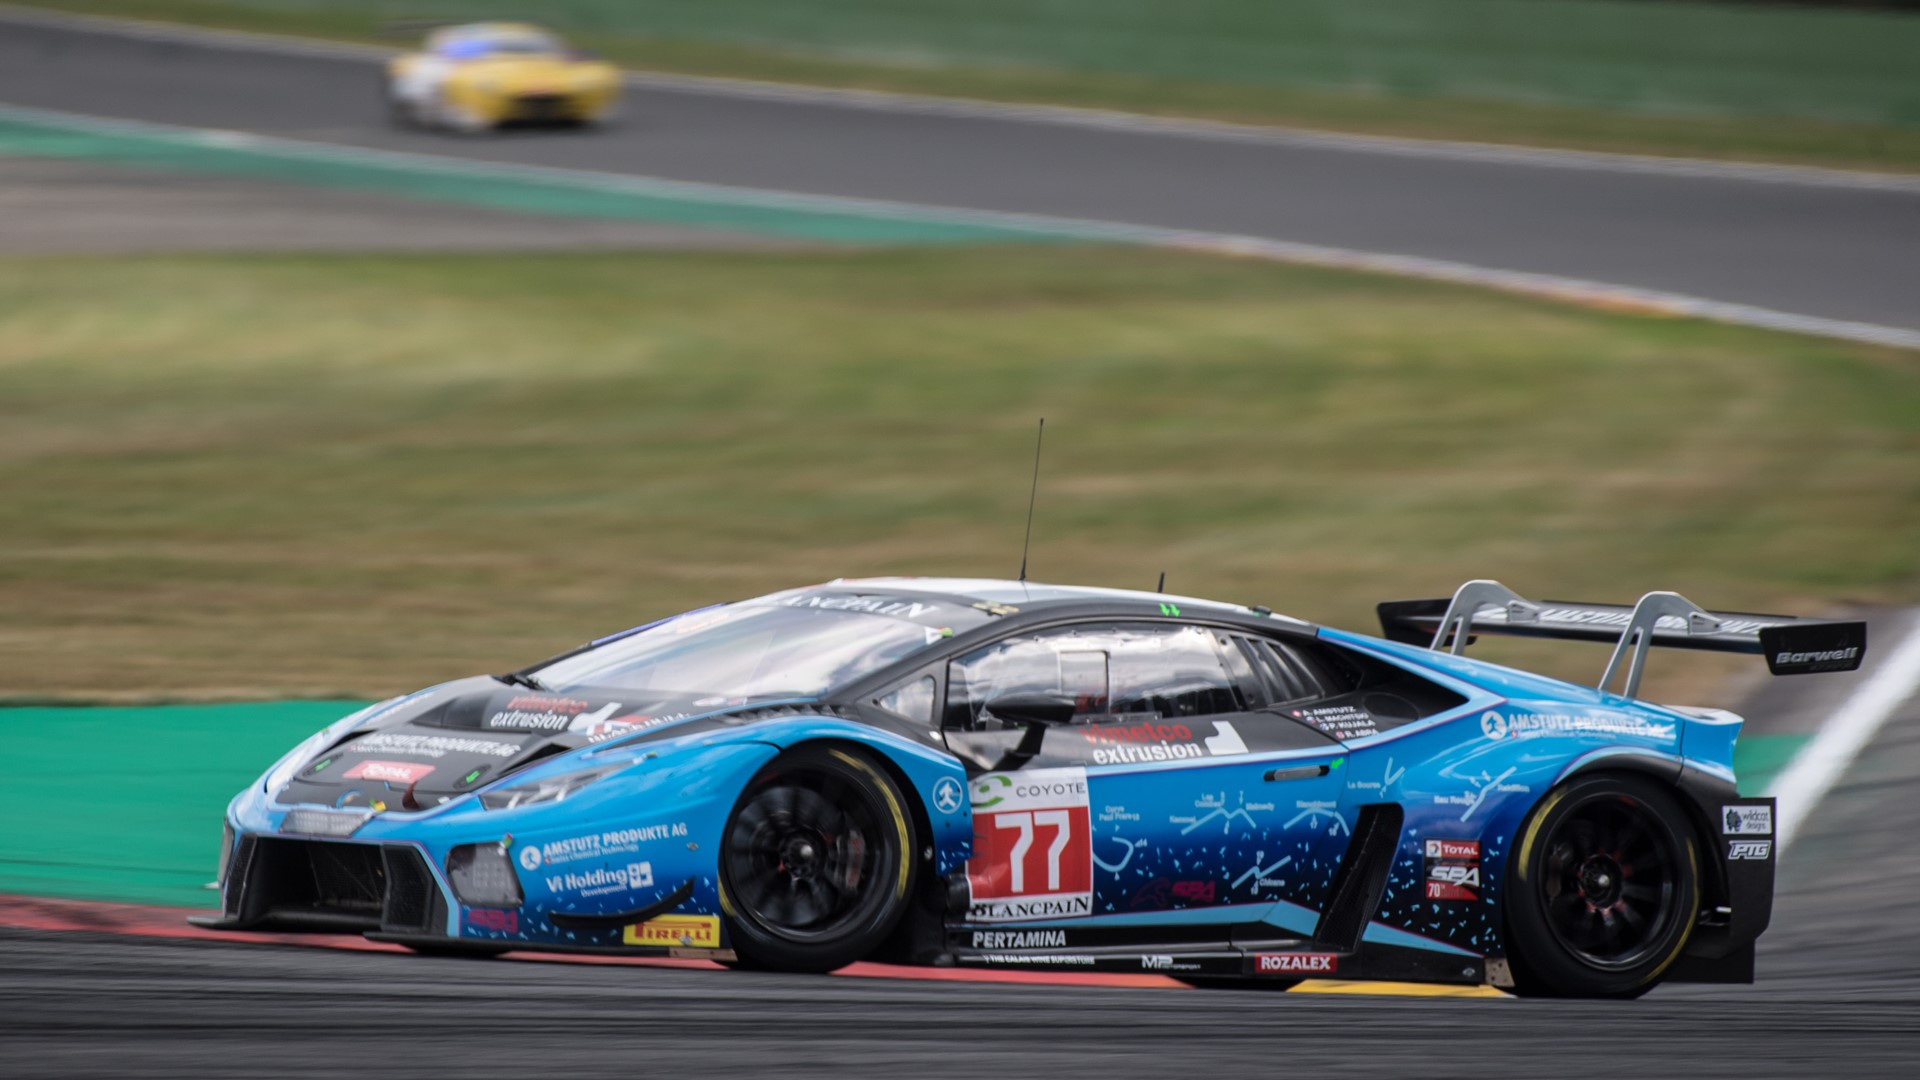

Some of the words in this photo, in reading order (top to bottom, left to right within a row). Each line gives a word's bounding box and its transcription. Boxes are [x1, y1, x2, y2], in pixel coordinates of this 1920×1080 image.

[1776, 647, 1859, 664] Barwell
[490, 710, 568, 731] extrusion
[1508, 713, 1570, 730] AMSTUTZ
[1079, 722, 1192, 744] vimetco
[1093, 740, 1203, 765] extrusion
[1016, 782, 1086, 798] COYOTE
[543, 834, 601, 858] AMSTUTZ
[602, 823, 670, 847] PRODUKTE
[671, 822, 688, 837] AG
[1443, 844, 1478, 855] TOTAL
[994, 810, 1070, 893] 77
[565, 868, 629, 890] Holding
[1431, 866, 1480, 887] SPA
[973, 897, 1090, 916] BLANCPAIN
[634, 921, 712, 940] PIRELLI
[972, 931, 1067, 948] PERTAMINA
[1260, 956, 1331, 970] ROZALEX
